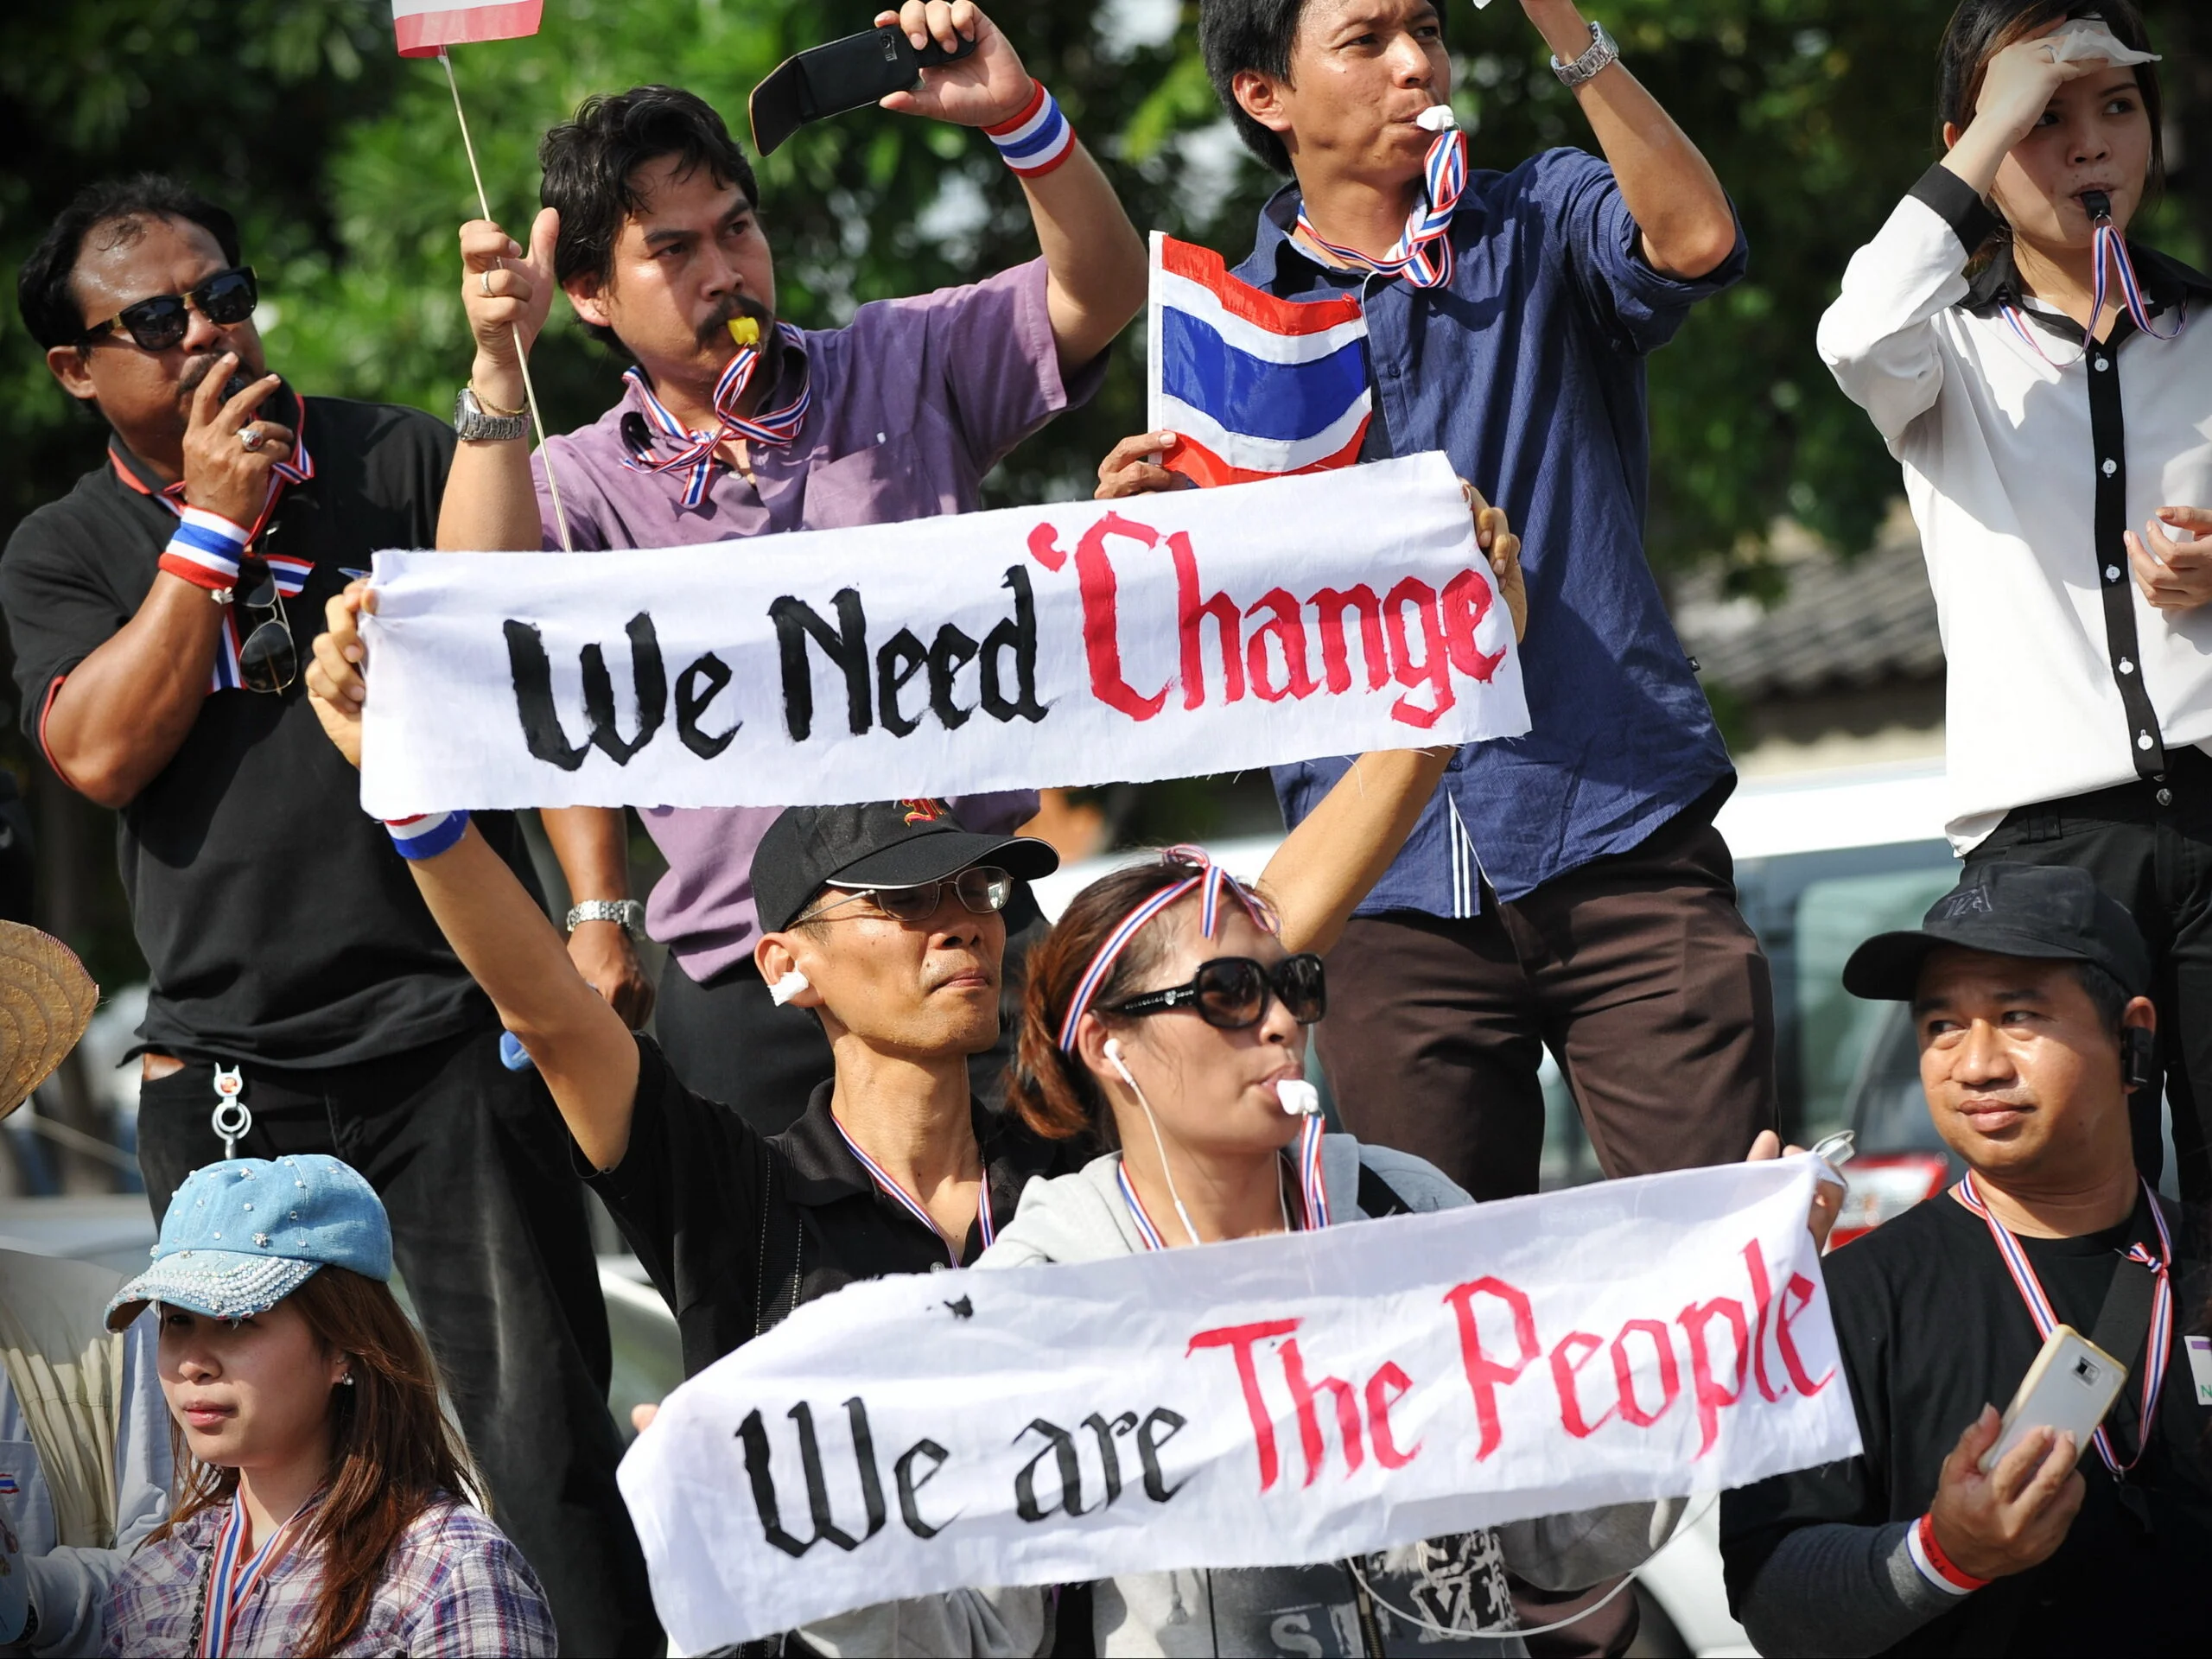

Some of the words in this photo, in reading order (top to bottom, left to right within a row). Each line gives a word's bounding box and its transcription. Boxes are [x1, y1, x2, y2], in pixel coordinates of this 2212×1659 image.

[503, 611, 743, 772] We
[767, 563, 1051, 742] Need
[734, 1396, 956, 1559] We
[1014, 1407, 1187, 1523] are
[1186, 1317, 1421, 1492] The
[1443, 1237, 1834, 1463] People
